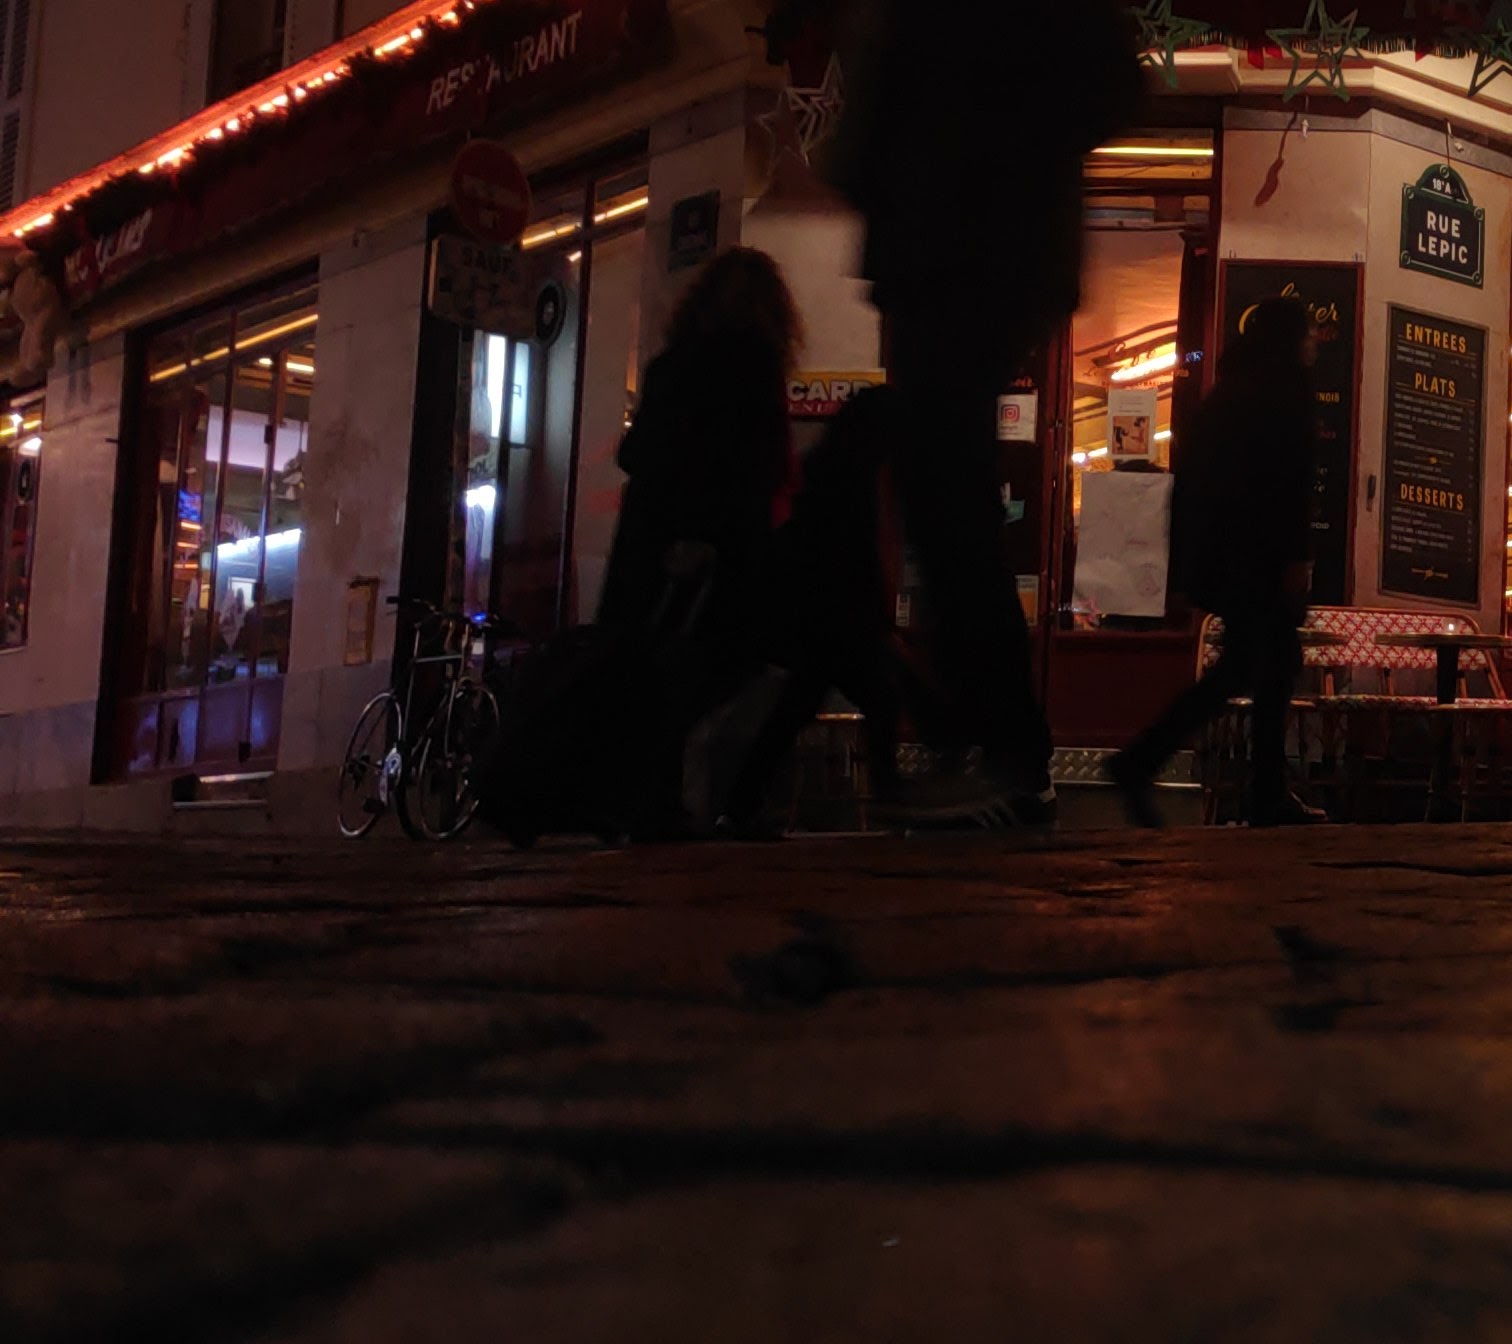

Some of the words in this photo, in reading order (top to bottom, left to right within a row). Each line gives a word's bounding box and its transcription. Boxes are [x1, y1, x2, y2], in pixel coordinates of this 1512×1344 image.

[425, 9, 583, 115] RESAURANT
[1426, 209, 1462, 238] RUE
[1417, 232, 1468, 265] LEPIC
[1414, 372, 1457, 399] PLATS
[1400, 482, 1465, 512] DESSERTS
